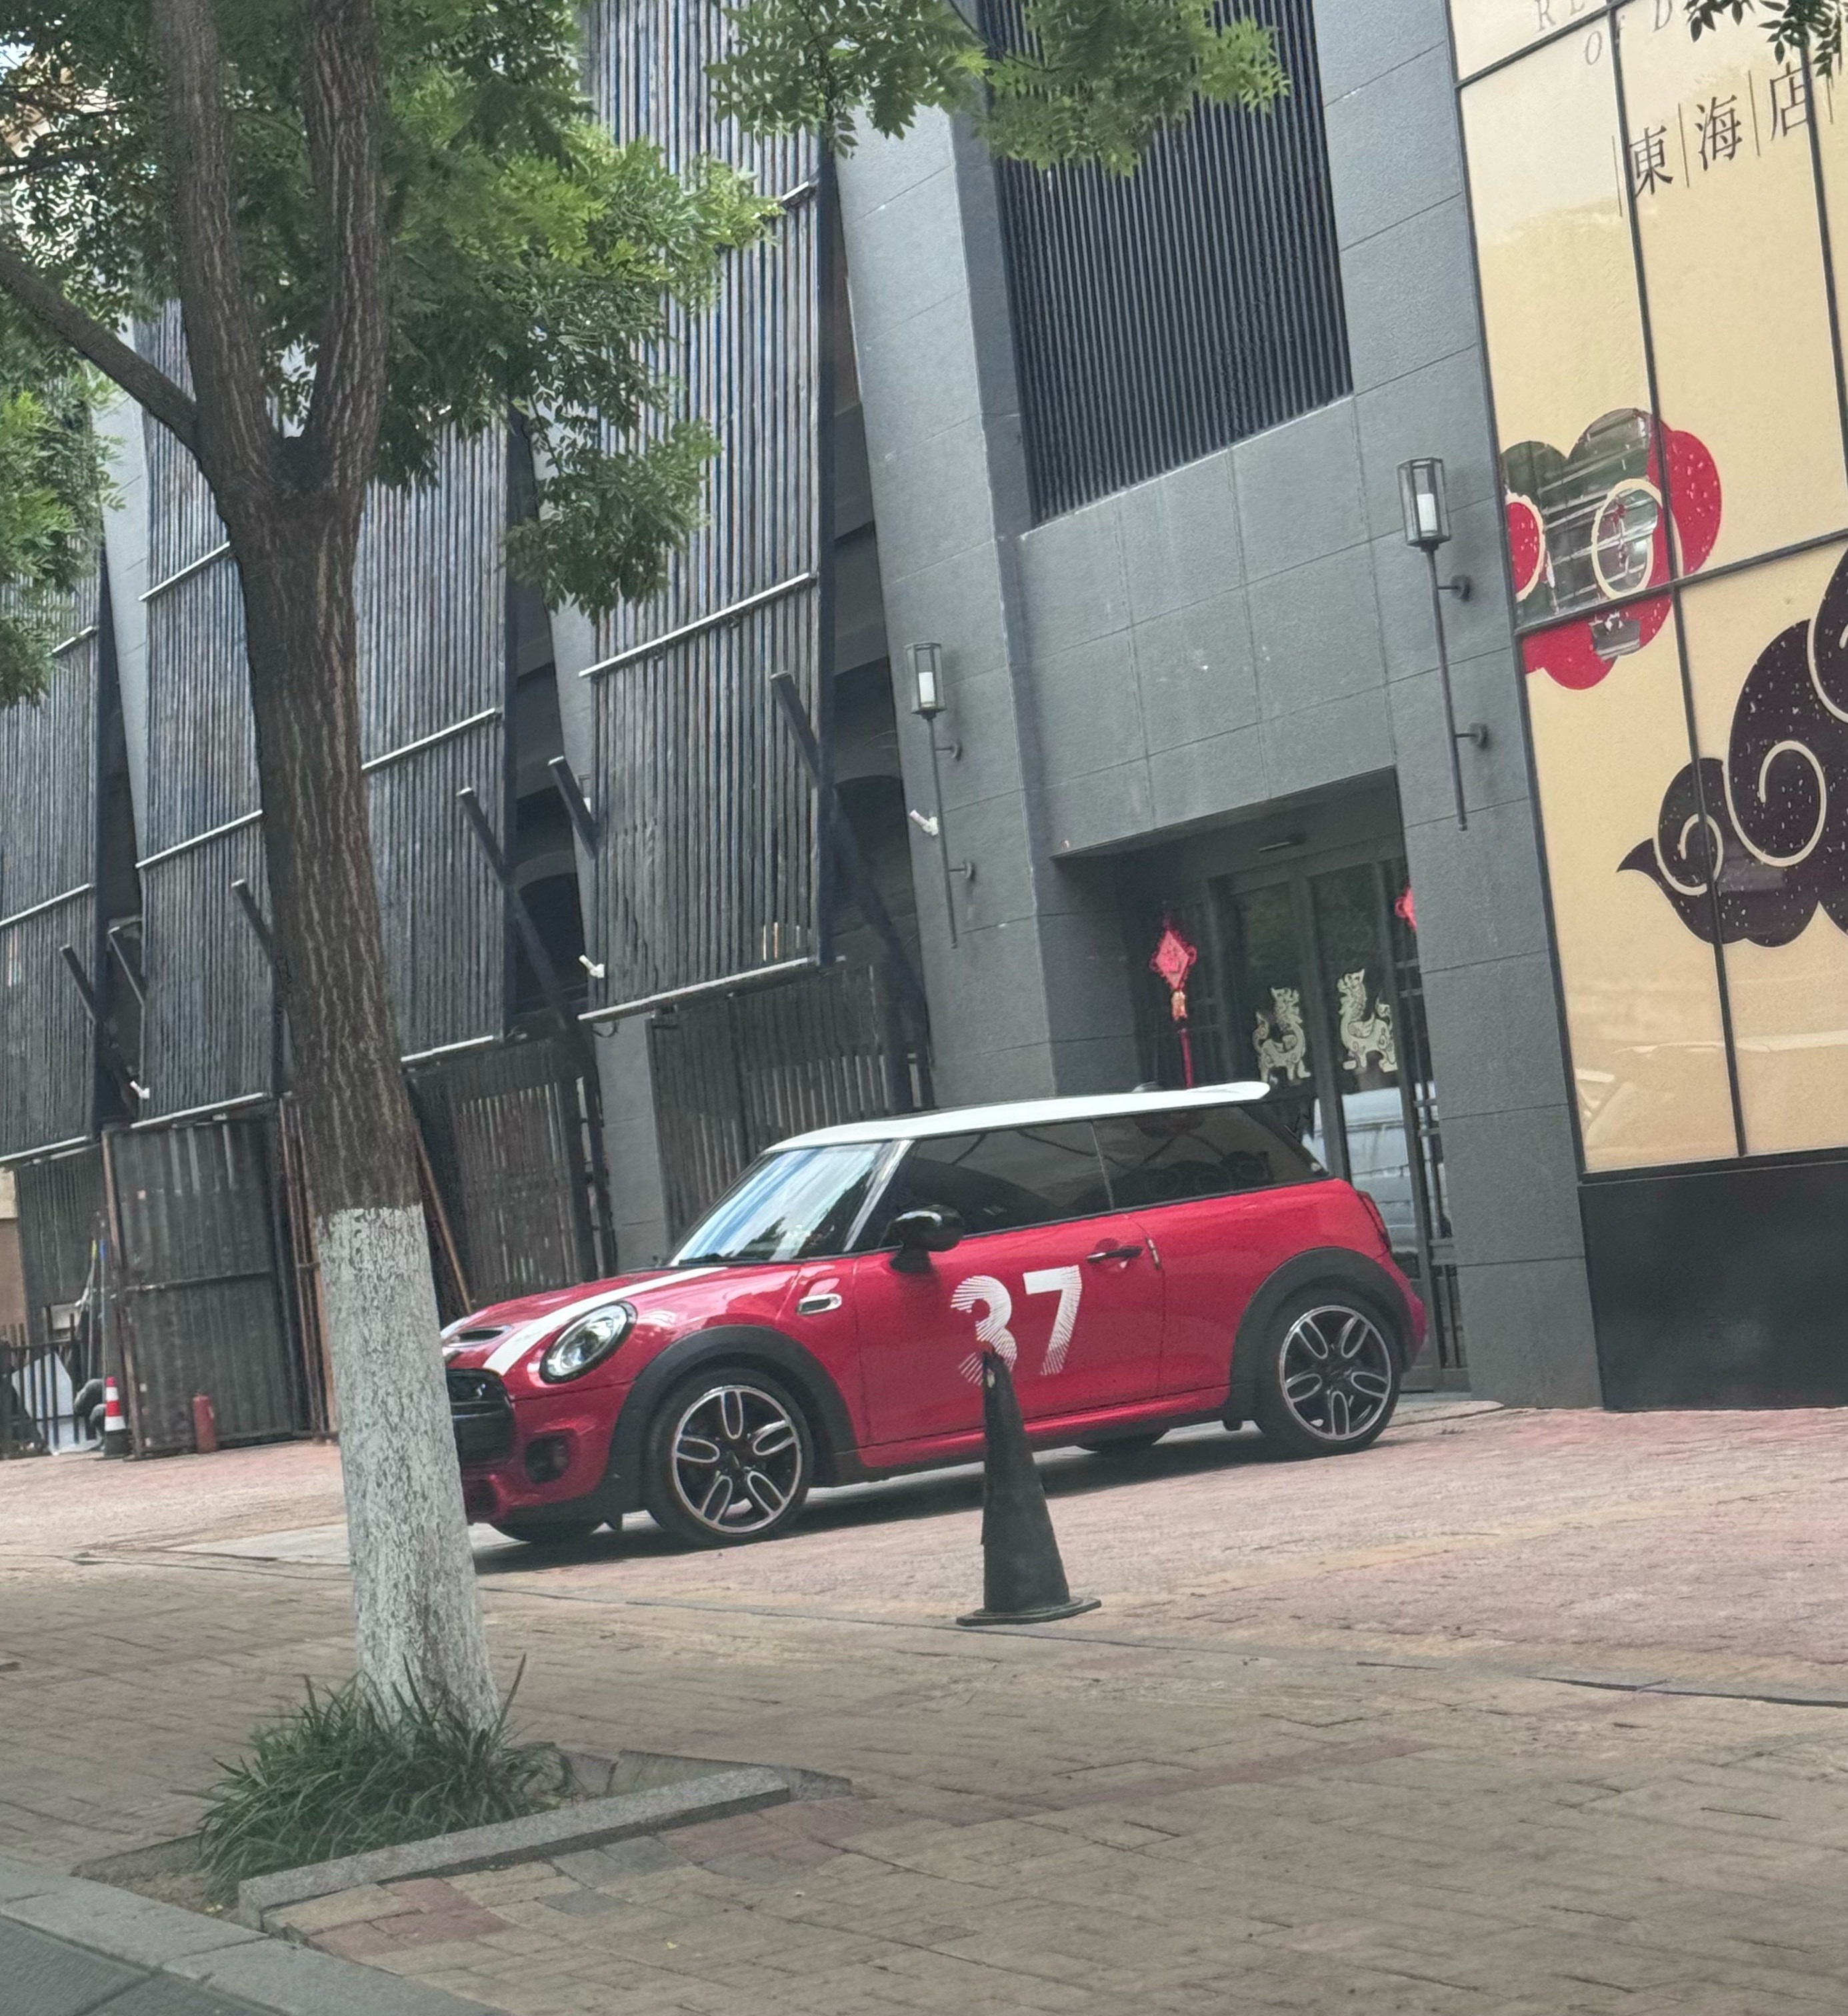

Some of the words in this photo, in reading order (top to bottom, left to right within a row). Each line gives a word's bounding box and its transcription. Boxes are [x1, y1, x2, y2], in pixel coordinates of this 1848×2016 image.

[1629, 61, 1807, 197] 東海店
[951, 1265, 1082, 1387] 37
